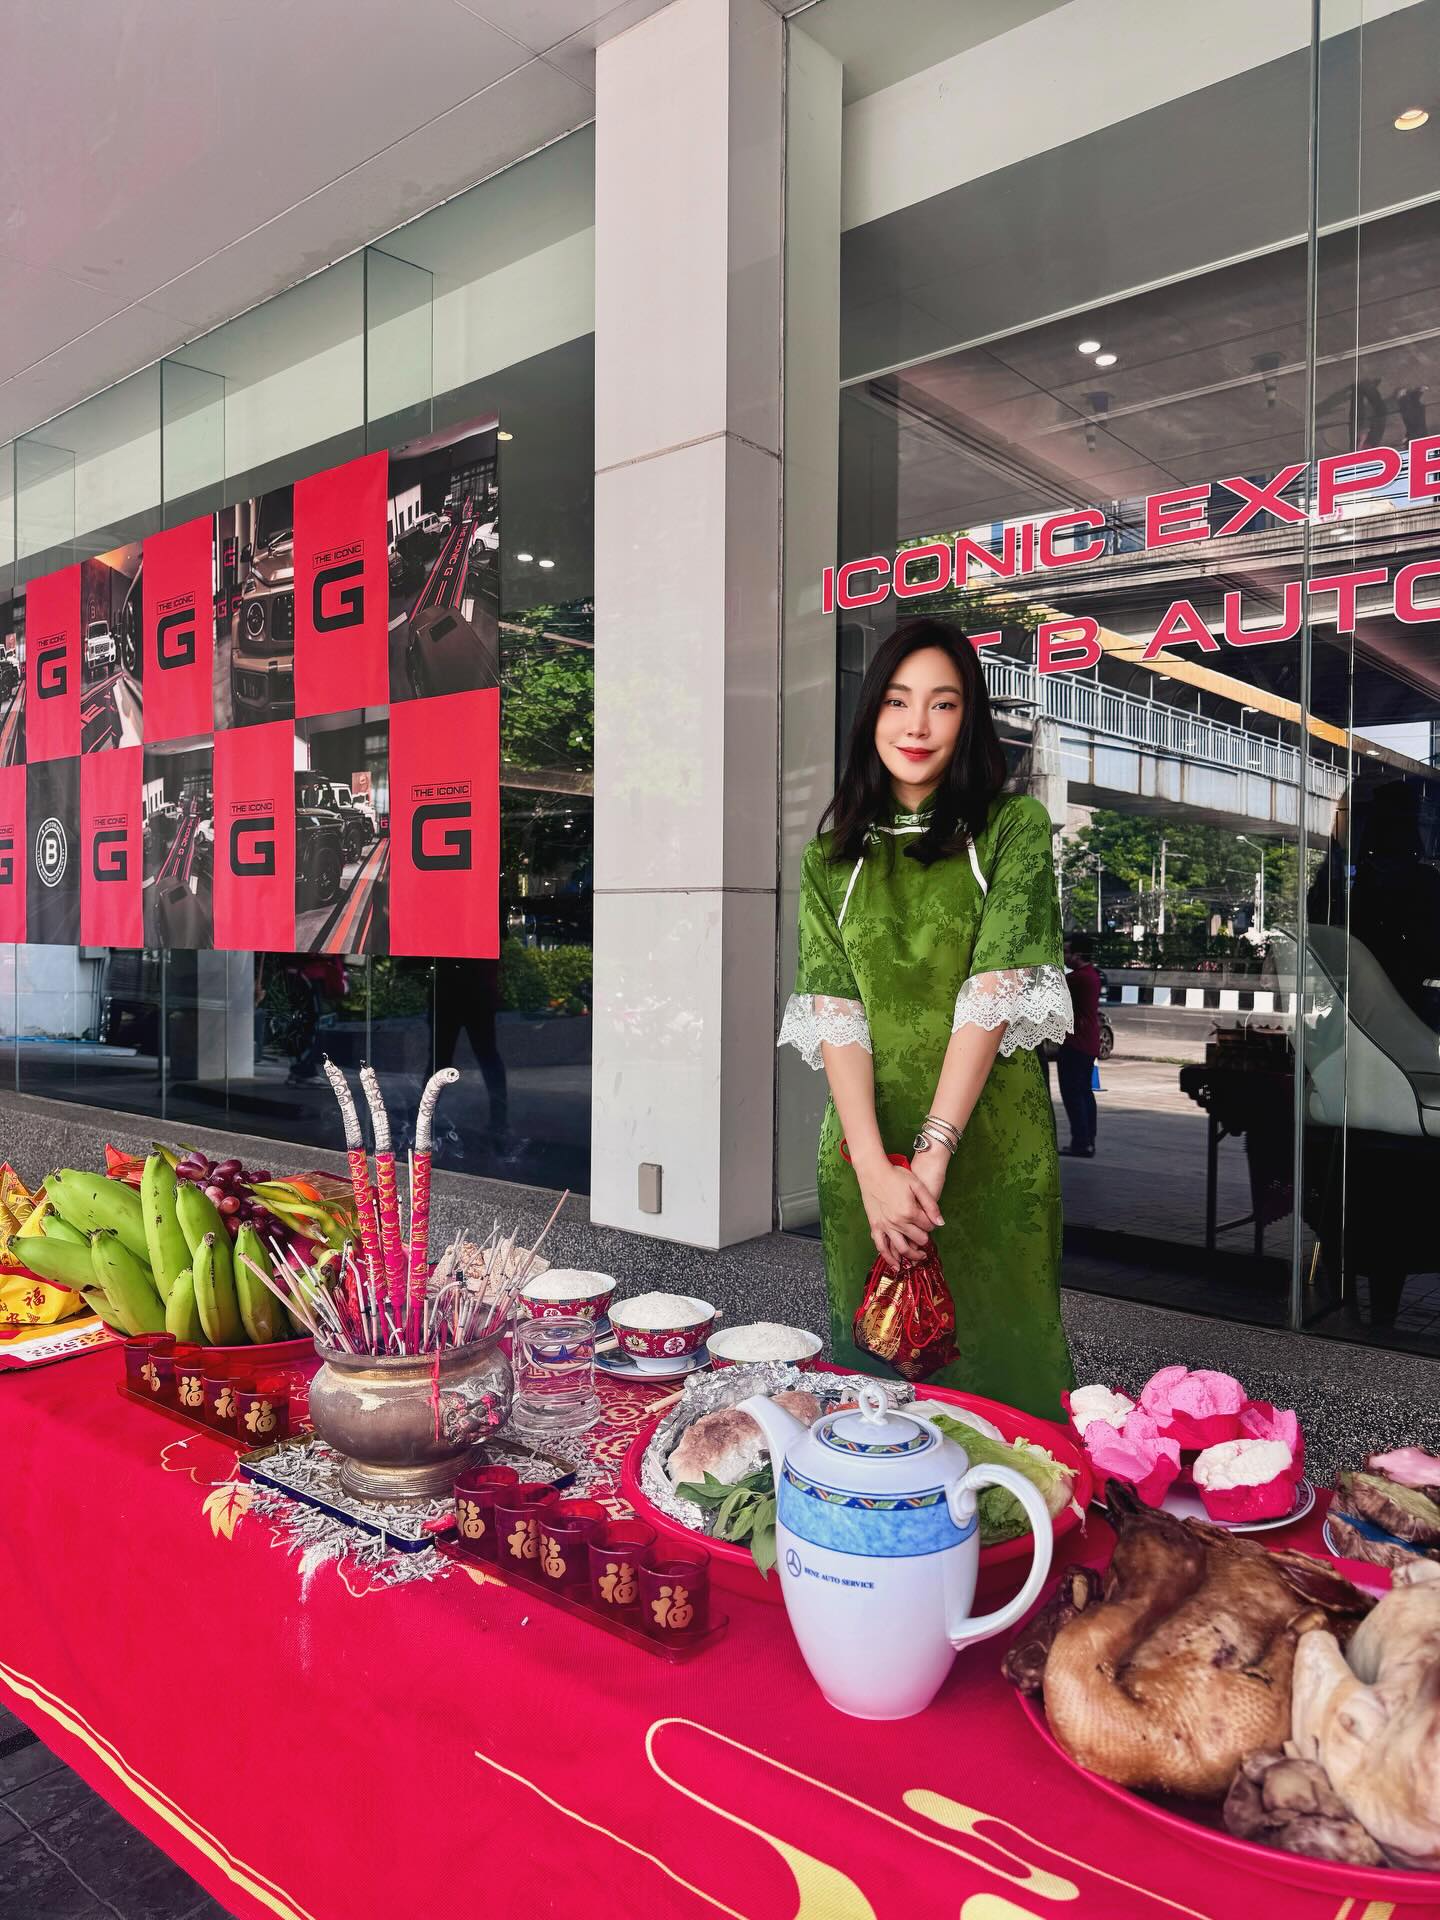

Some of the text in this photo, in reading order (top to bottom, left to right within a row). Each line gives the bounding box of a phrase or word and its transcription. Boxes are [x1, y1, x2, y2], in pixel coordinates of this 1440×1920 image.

[314, 544, 362, 564] THE ICONIC
[822, 509, 1105, 614] ICONIC
[158, 602, 173, 611] THE
[313, 559, 364, 634] G
[157, 607, 196, 671] G
[1037, 616, 1102, 675] B
[37, 646, 67, 700] G
[231, 802, 273, 813] THE ICONIC
[414, 785, 470, 798] THE ICONIC
[45, 839, 58, 866] B
[92, 829, 128, 882] G
[229, 816, 275, 877] G
[411, 801, 471, 872] G
[178, 1376, 204, 1407] 福
[244, 1400, 276, 1433] 福
[456, 1498, 486, 1539] 福
[598, 1562, 637, 1604] 福
[804, 1566, 875, 1590] BENZ AUTO SERVICE
[651, 1585, 694, 1629] 福
